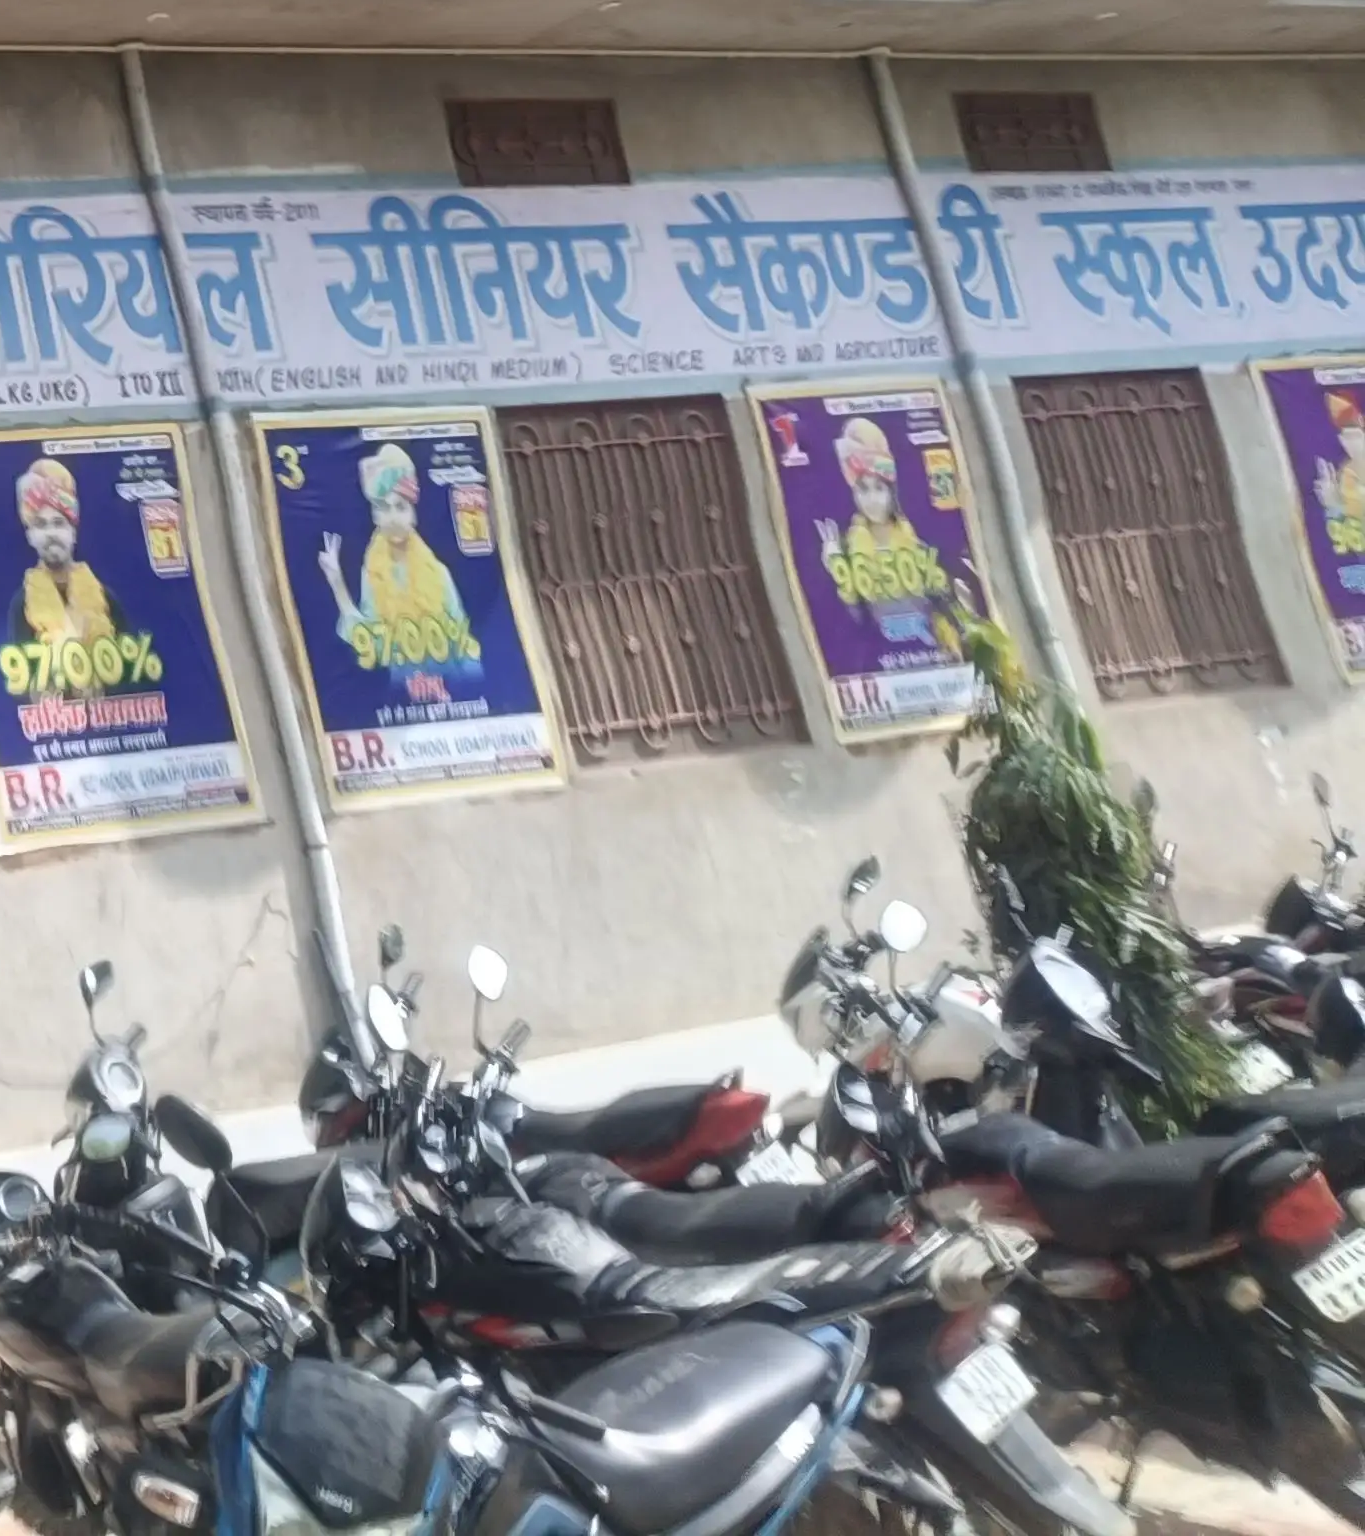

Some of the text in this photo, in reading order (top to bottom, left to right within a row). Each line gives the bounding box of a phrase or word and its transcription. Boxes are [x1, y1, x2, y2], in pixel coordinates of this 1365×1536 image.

[310, 192, 642, 350] सीनियर
[270, 365, 364, 392] ENGLISH
[607, 348, 705, 376] SCIENCE
[835, 335, 941, 362] AGRICULTURE
[332, 730, 396, 772] B.R.
